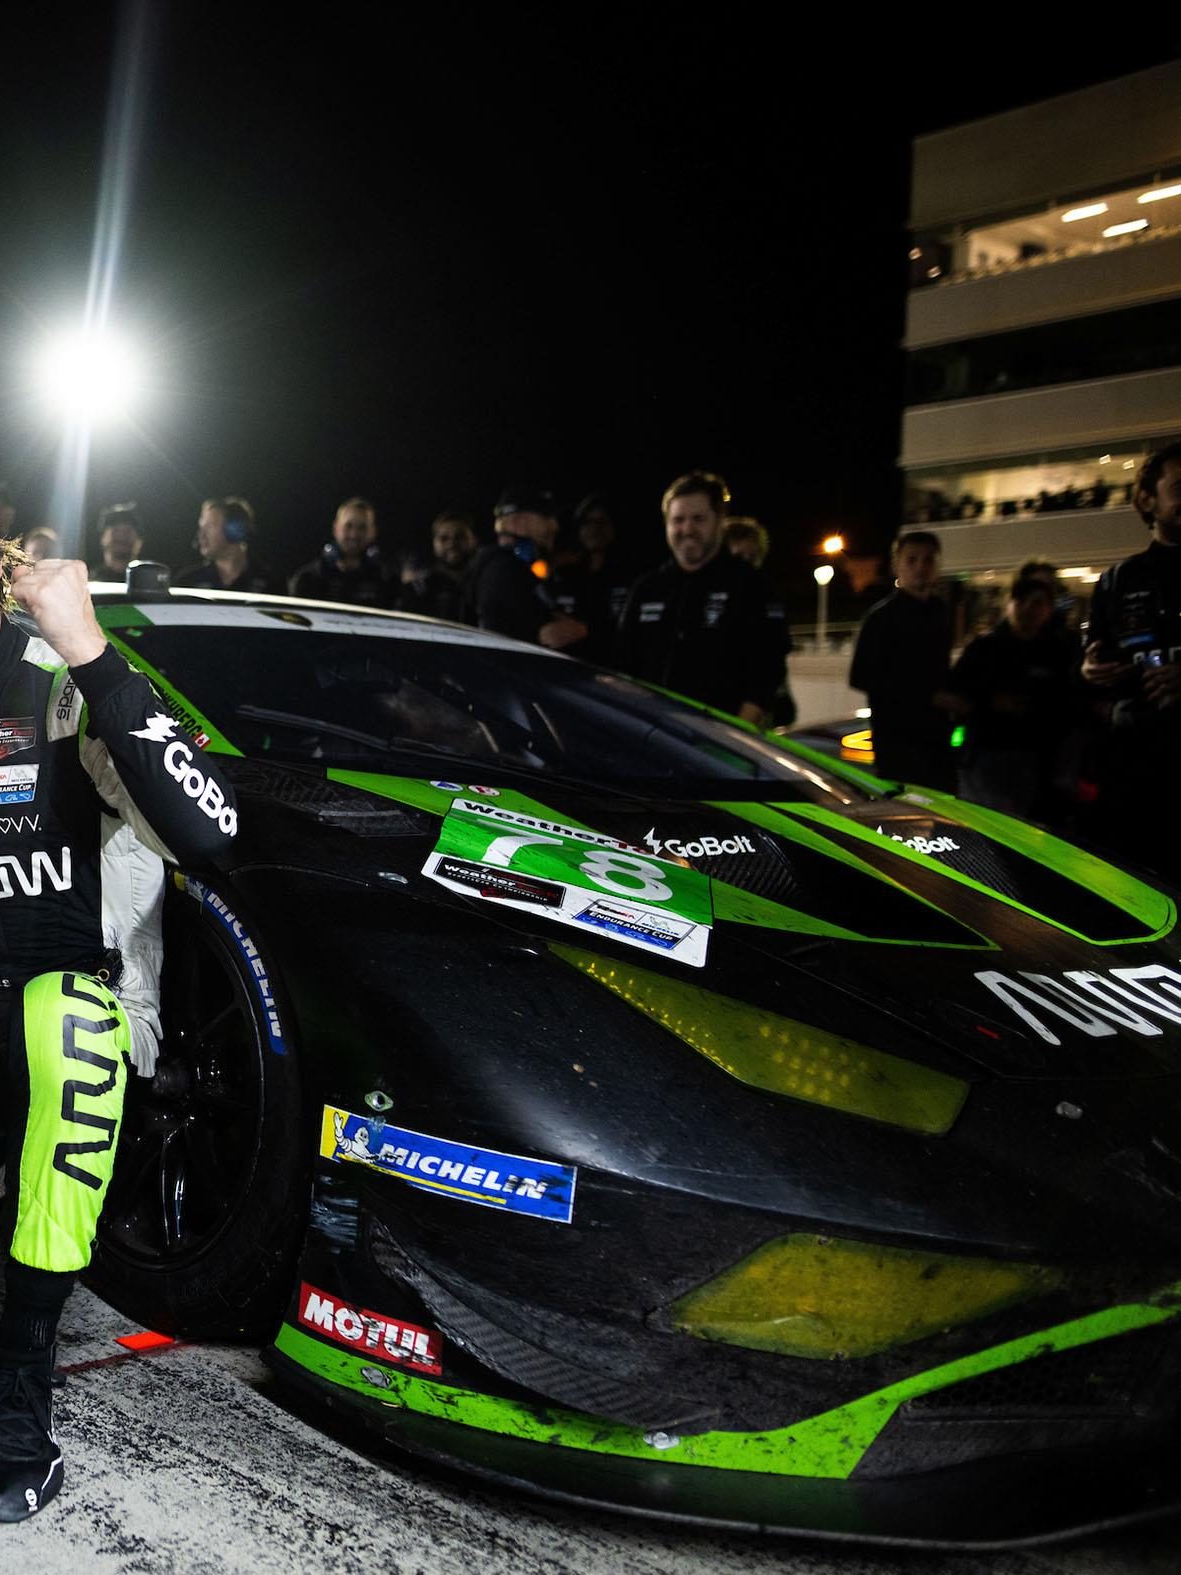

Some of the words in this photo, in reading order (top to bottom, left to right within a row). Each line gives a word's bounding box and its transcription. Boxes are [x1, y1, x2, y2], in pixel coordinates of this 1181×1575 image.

[56, 678, 75, 720] spar
[164, 741, 238, 837] GoBo
[463, 801, 648, 856] WeatherTe
[664, 835, 756, 858] GoBolt
[474, 818, 673, 901] 78
[588, 910, 651, 934] ENDURANCE
[651, 929, 674, 941] CUP
[207, 892, 282, 1037] MICHELIN
[379, 1142, 549, 1199] MICHELIN
[303, 1292, 435, 1366] MOTUL
